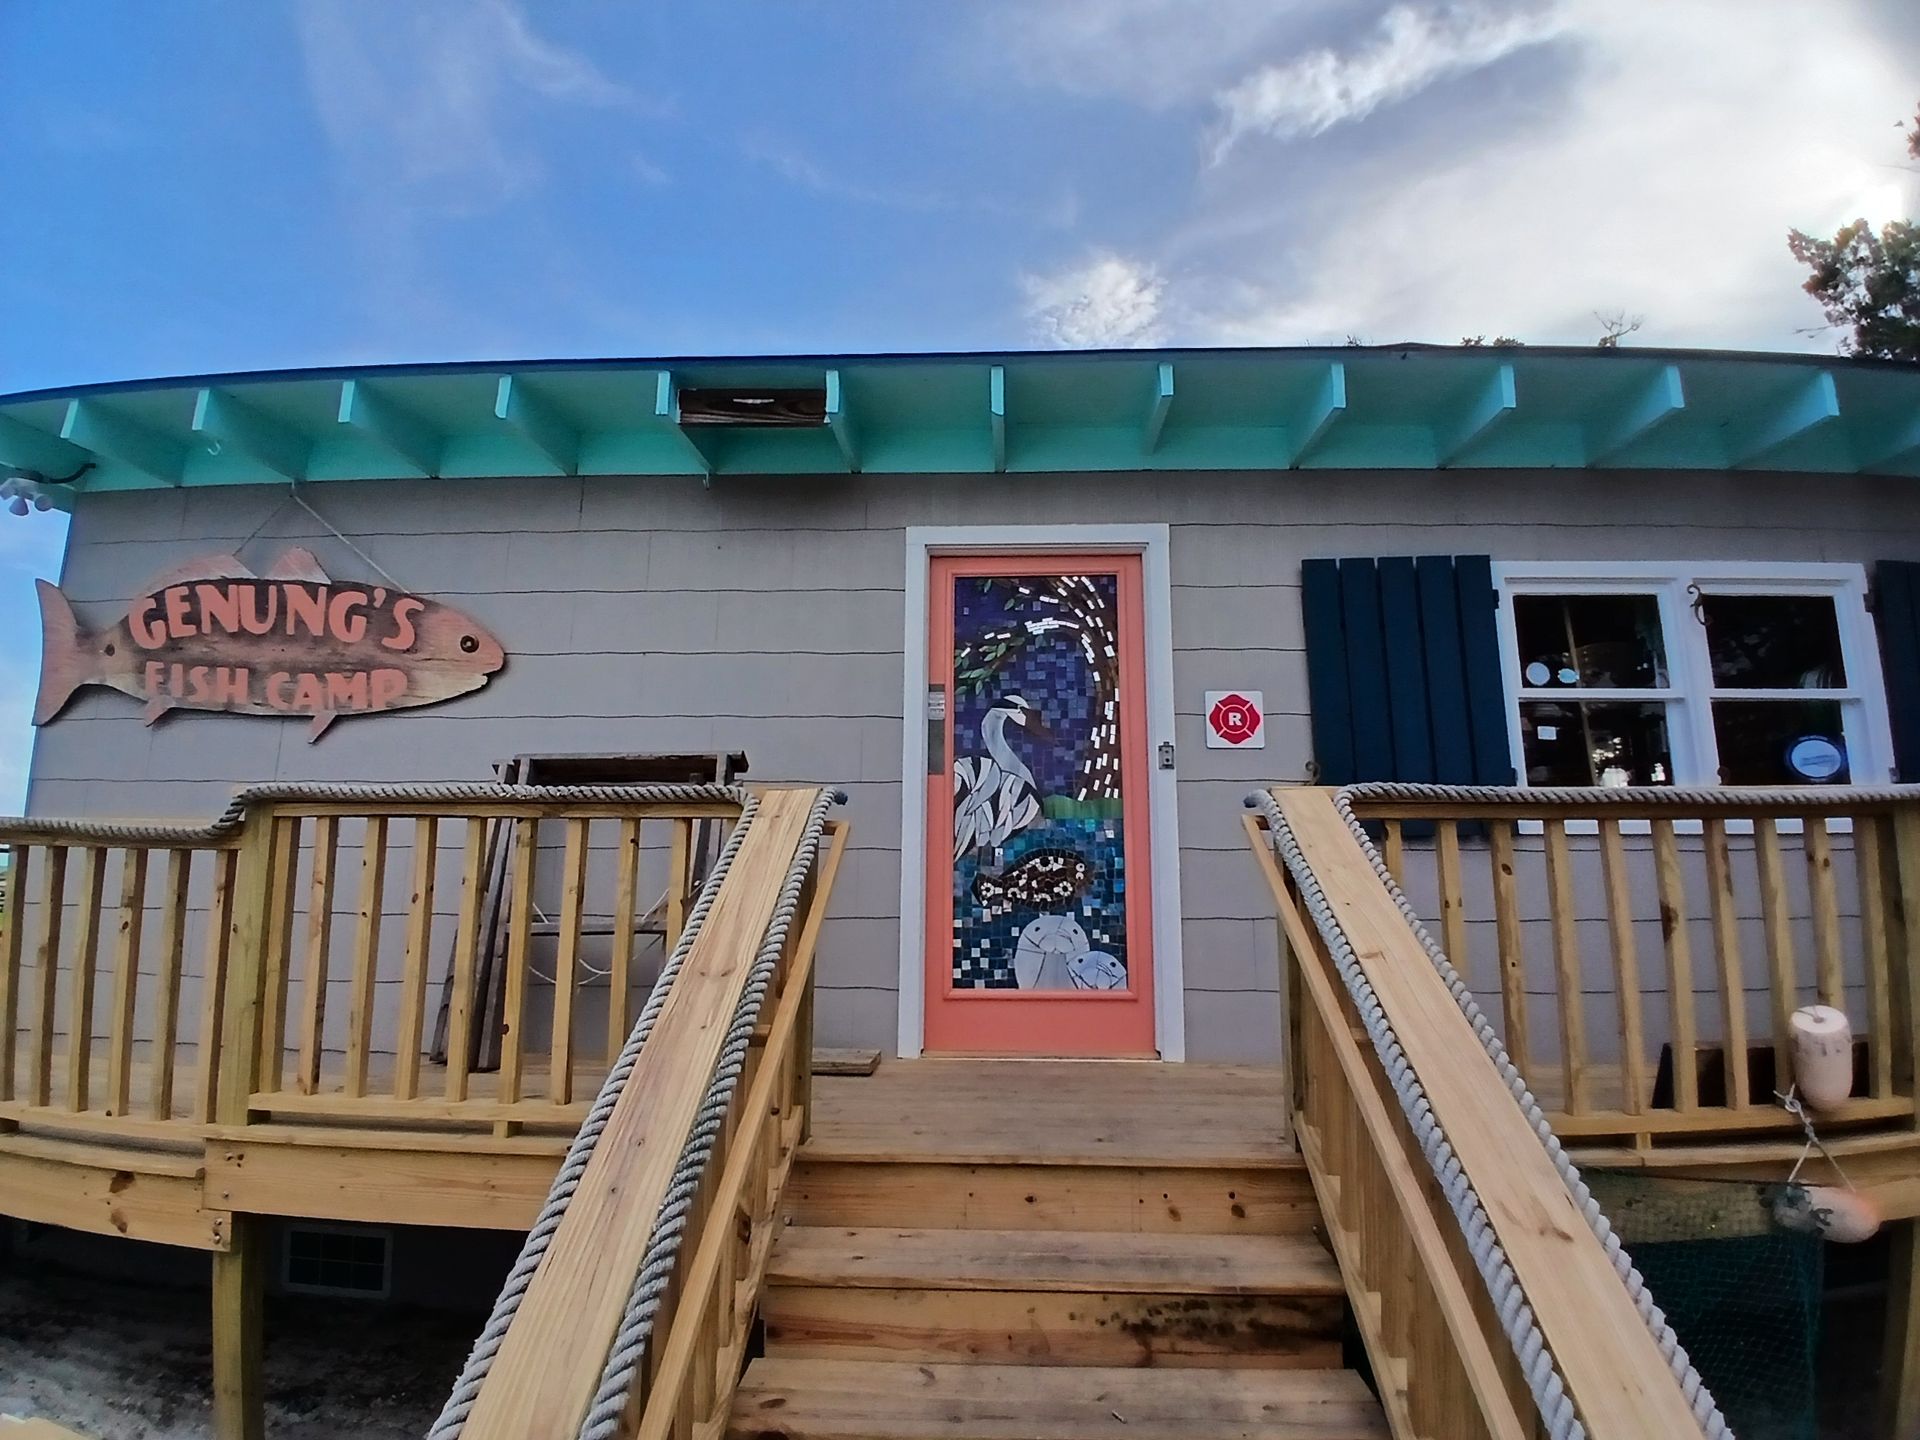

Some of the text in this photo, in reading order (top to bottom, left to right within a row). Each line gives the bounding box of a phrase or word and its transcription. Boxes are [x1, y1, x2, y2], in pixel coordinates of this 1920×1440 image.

[129, 585, 424, 649] GENUNG'S
[145, 661, 408, 710] FISH CAMP
[1228, 712, 1242, 726] R
